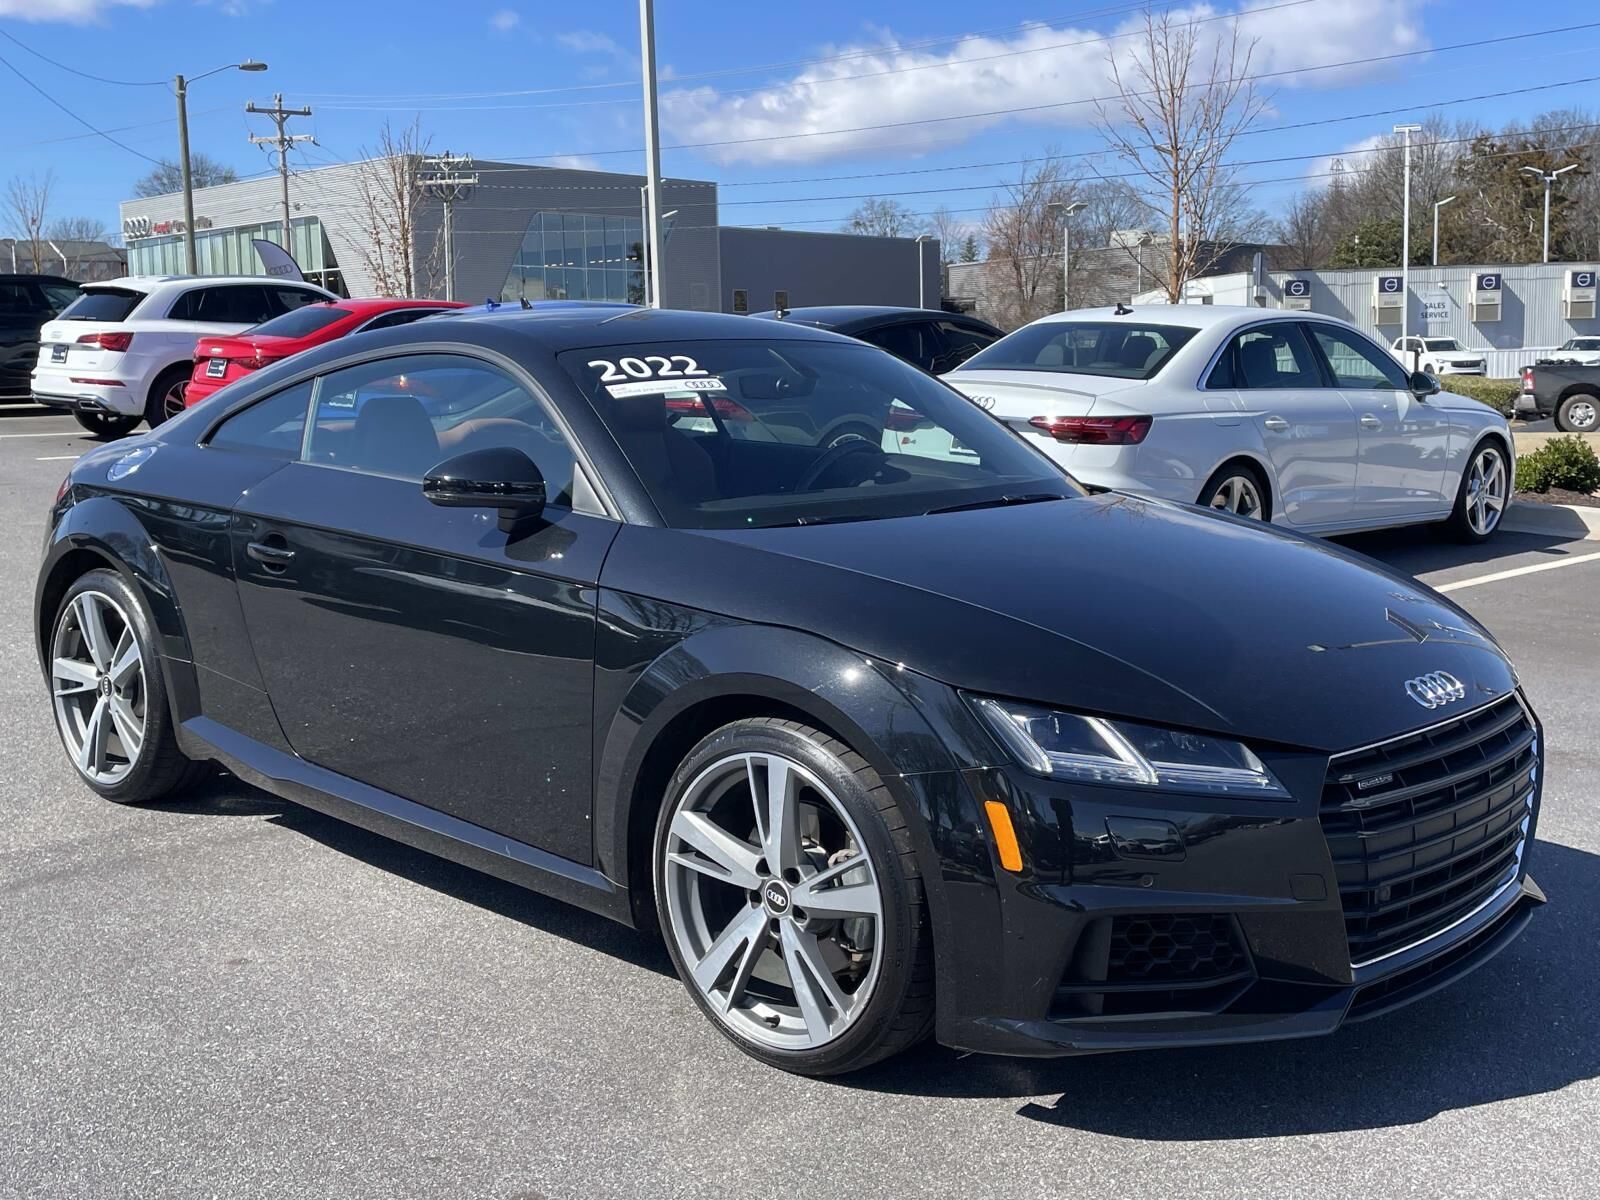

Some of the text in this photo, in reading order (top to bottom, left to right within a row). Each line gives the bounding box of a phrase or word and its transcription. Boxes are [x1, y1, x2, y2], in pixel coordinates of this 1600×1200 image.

[1424, 302, 1446, 310] SALES
[1420, 311, 1449, 319] SERVICE
[587, 355, 709, 382] 2022
